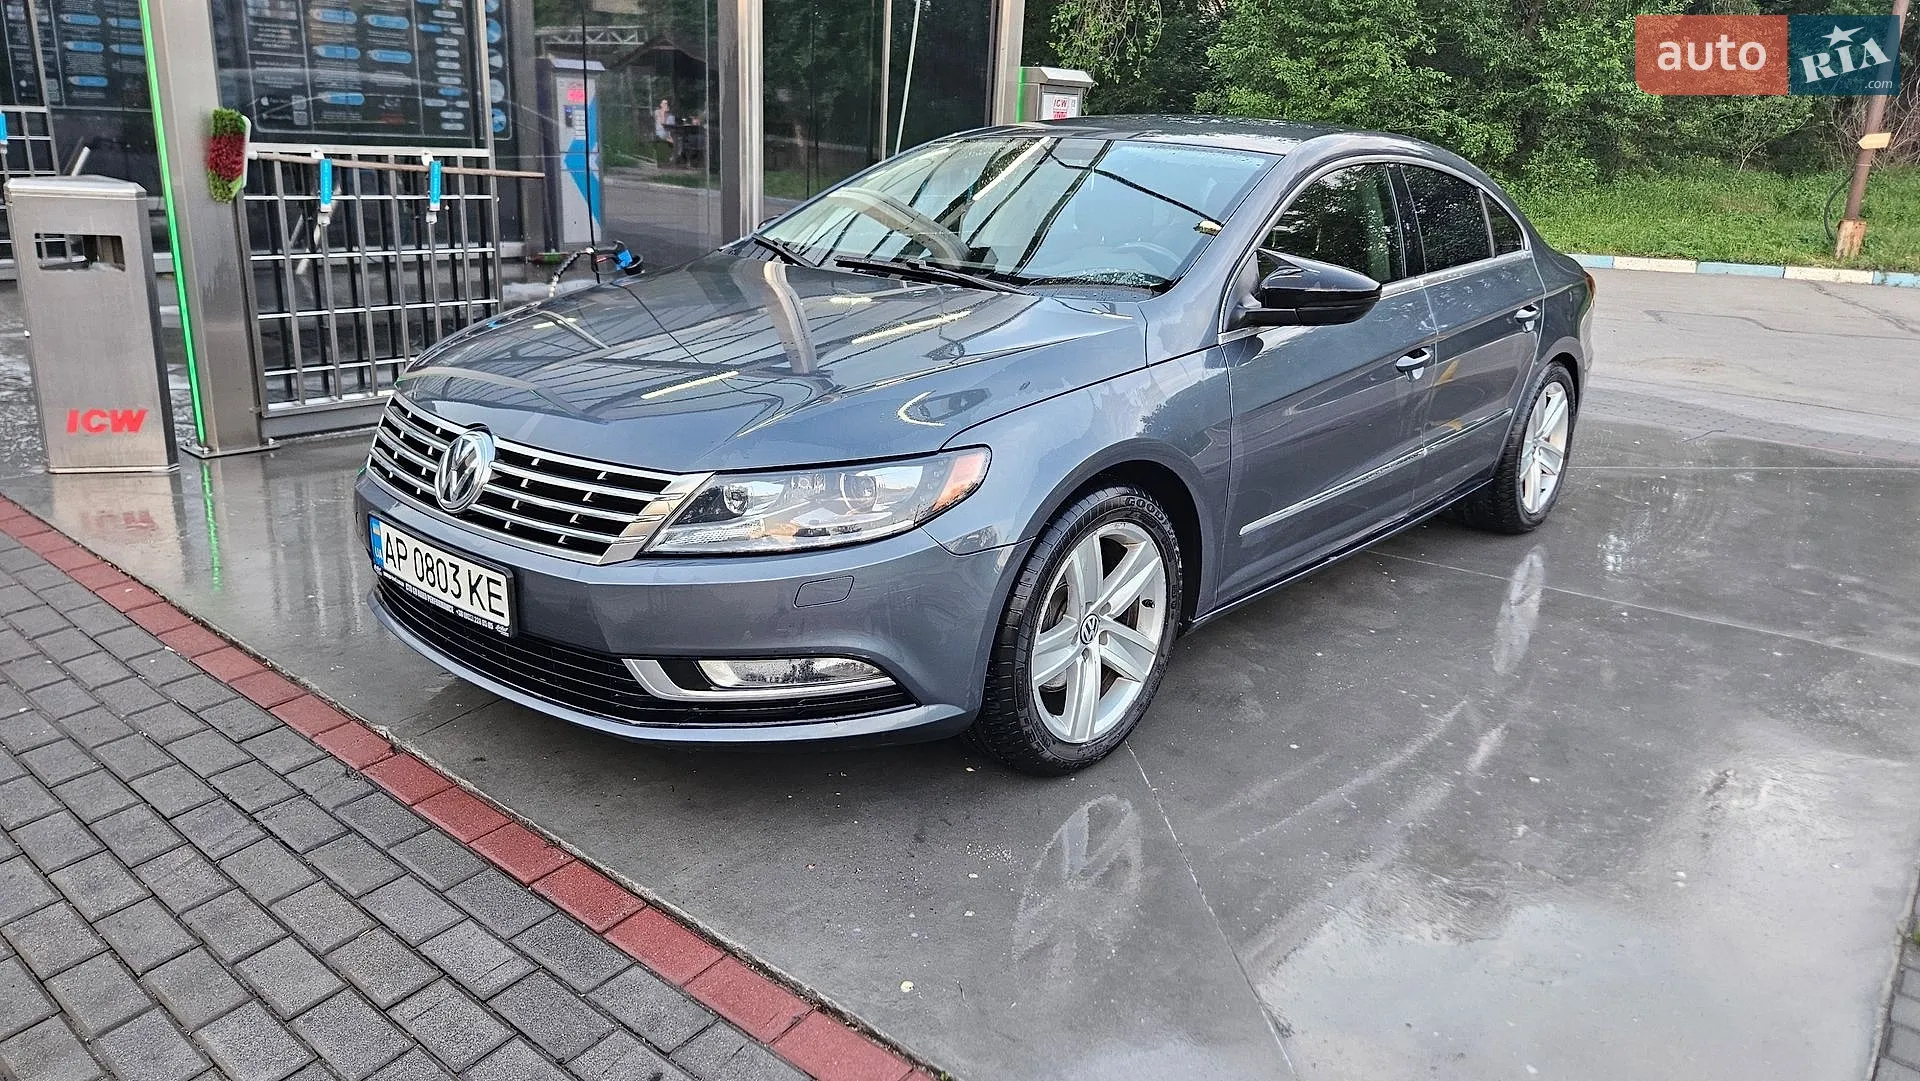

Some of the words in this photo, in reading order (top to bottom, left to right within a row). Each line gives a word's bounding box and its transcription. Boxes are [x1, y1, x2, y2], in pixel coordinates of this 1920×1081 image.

[67, 409, 148, 433] ICW
[374, 546, 384, 559] UA
[386, 532, 408, 571] AP
[414, 547, 462, 599] 0803
[467, 569, 505, 618] KE
